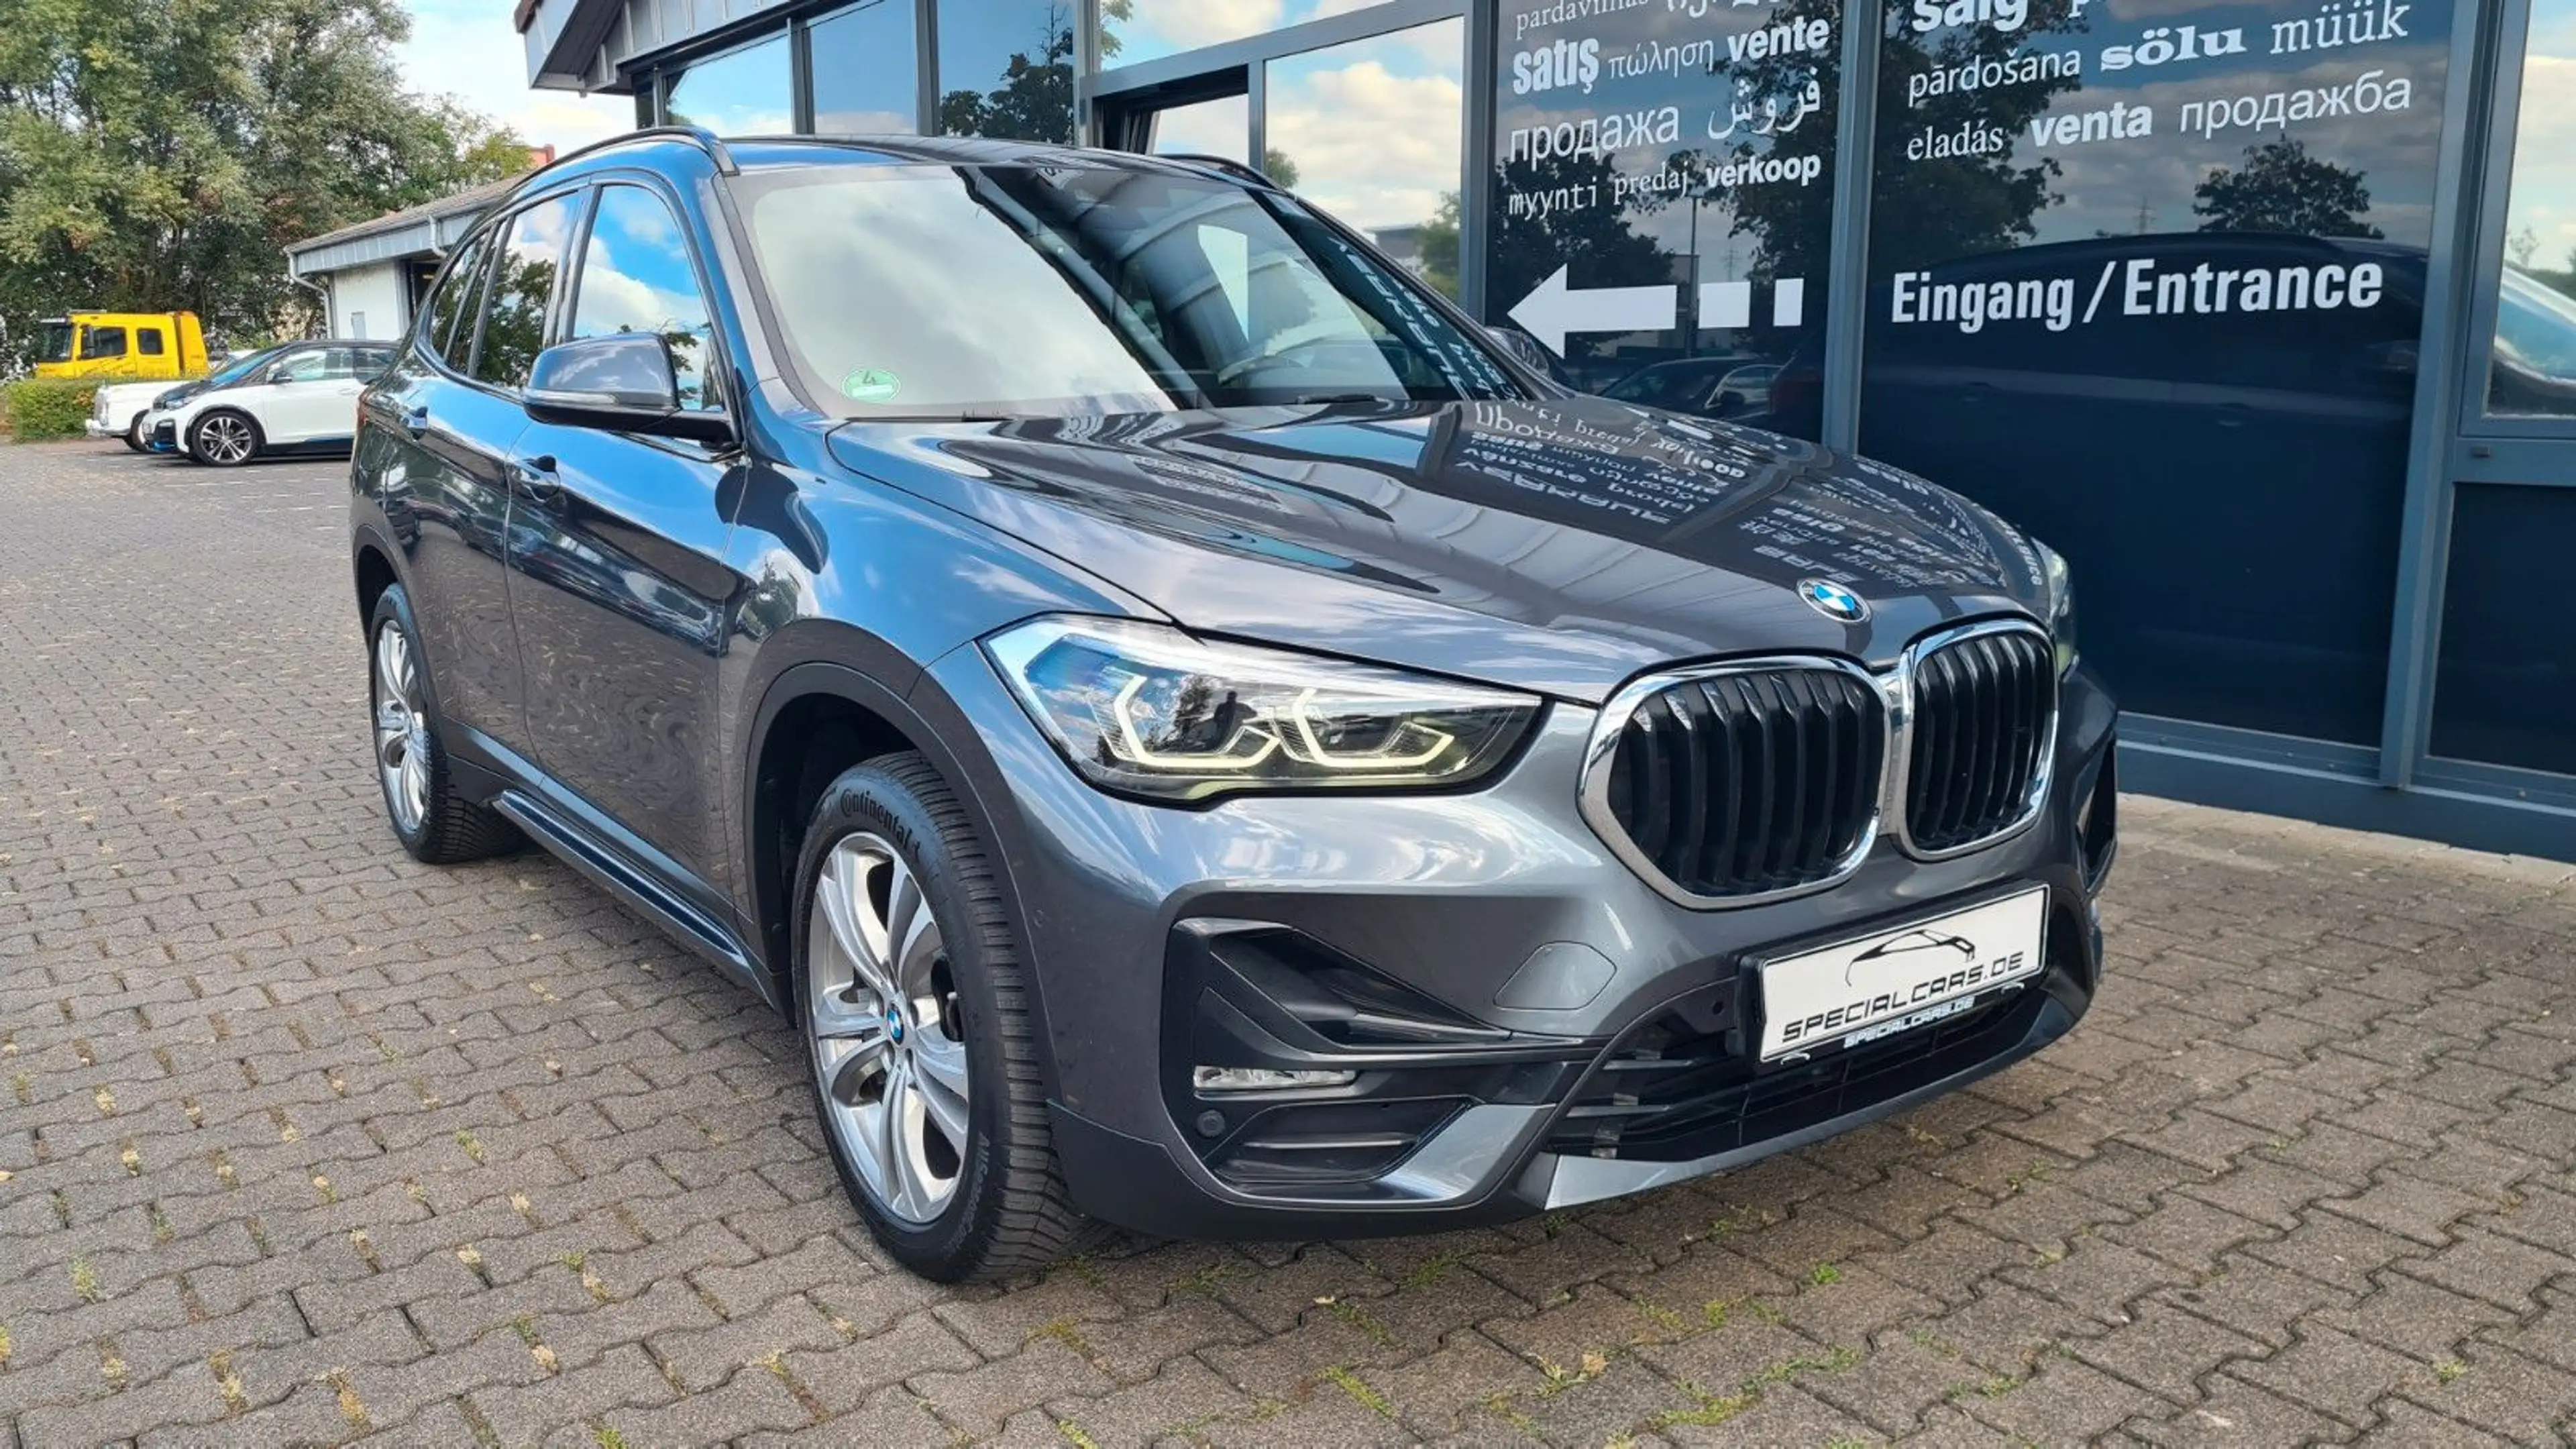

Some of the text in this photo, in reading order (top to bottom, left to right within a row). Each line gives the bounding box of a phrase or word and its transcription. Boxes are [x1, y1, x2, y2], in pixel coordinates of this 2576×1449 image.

[1513, 15, 1829, 94] satış πώληση vente
[1909, 0, 2411, 107] pārdošana sölu müük
[1509, 105, 1679, 170] продажа
[1907, 70, 2412, 162] eladás venta продажба
[1509, 154, 1821, 220] myynti predaj verkoop
[840, 788, 913, 847] Continental
